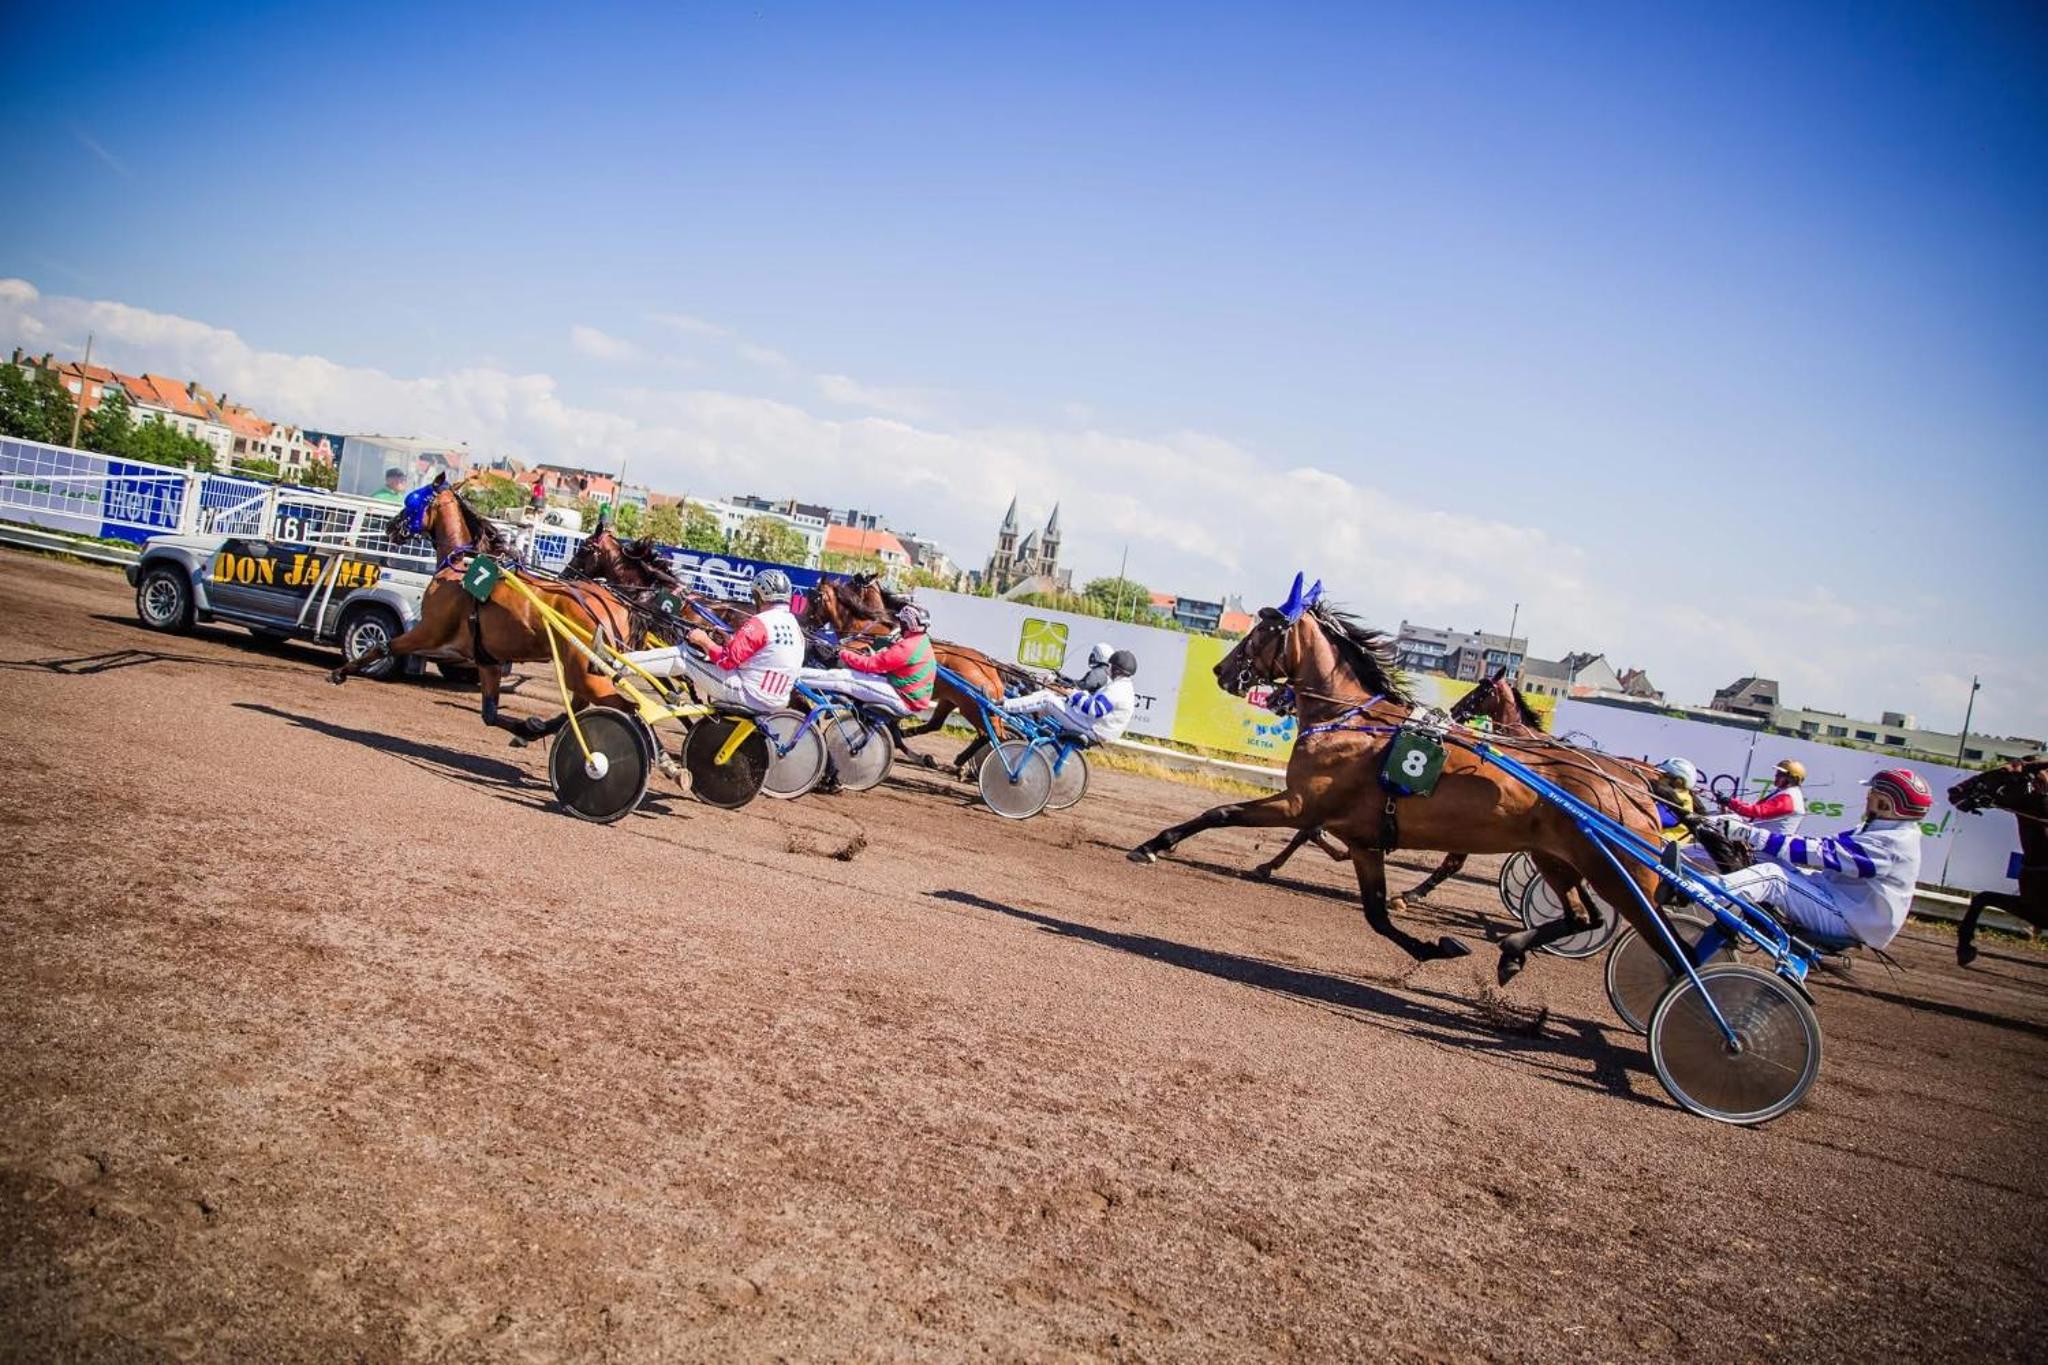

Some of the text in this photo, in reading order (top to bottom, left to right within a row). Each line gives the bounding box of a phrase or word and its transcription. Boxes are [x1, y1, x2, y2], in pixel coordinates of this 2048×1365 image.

[212, 552, 382, 589] DON JAME
[473, 566, 491, 586] 7
[1402, 749, 1428, 777] 8
